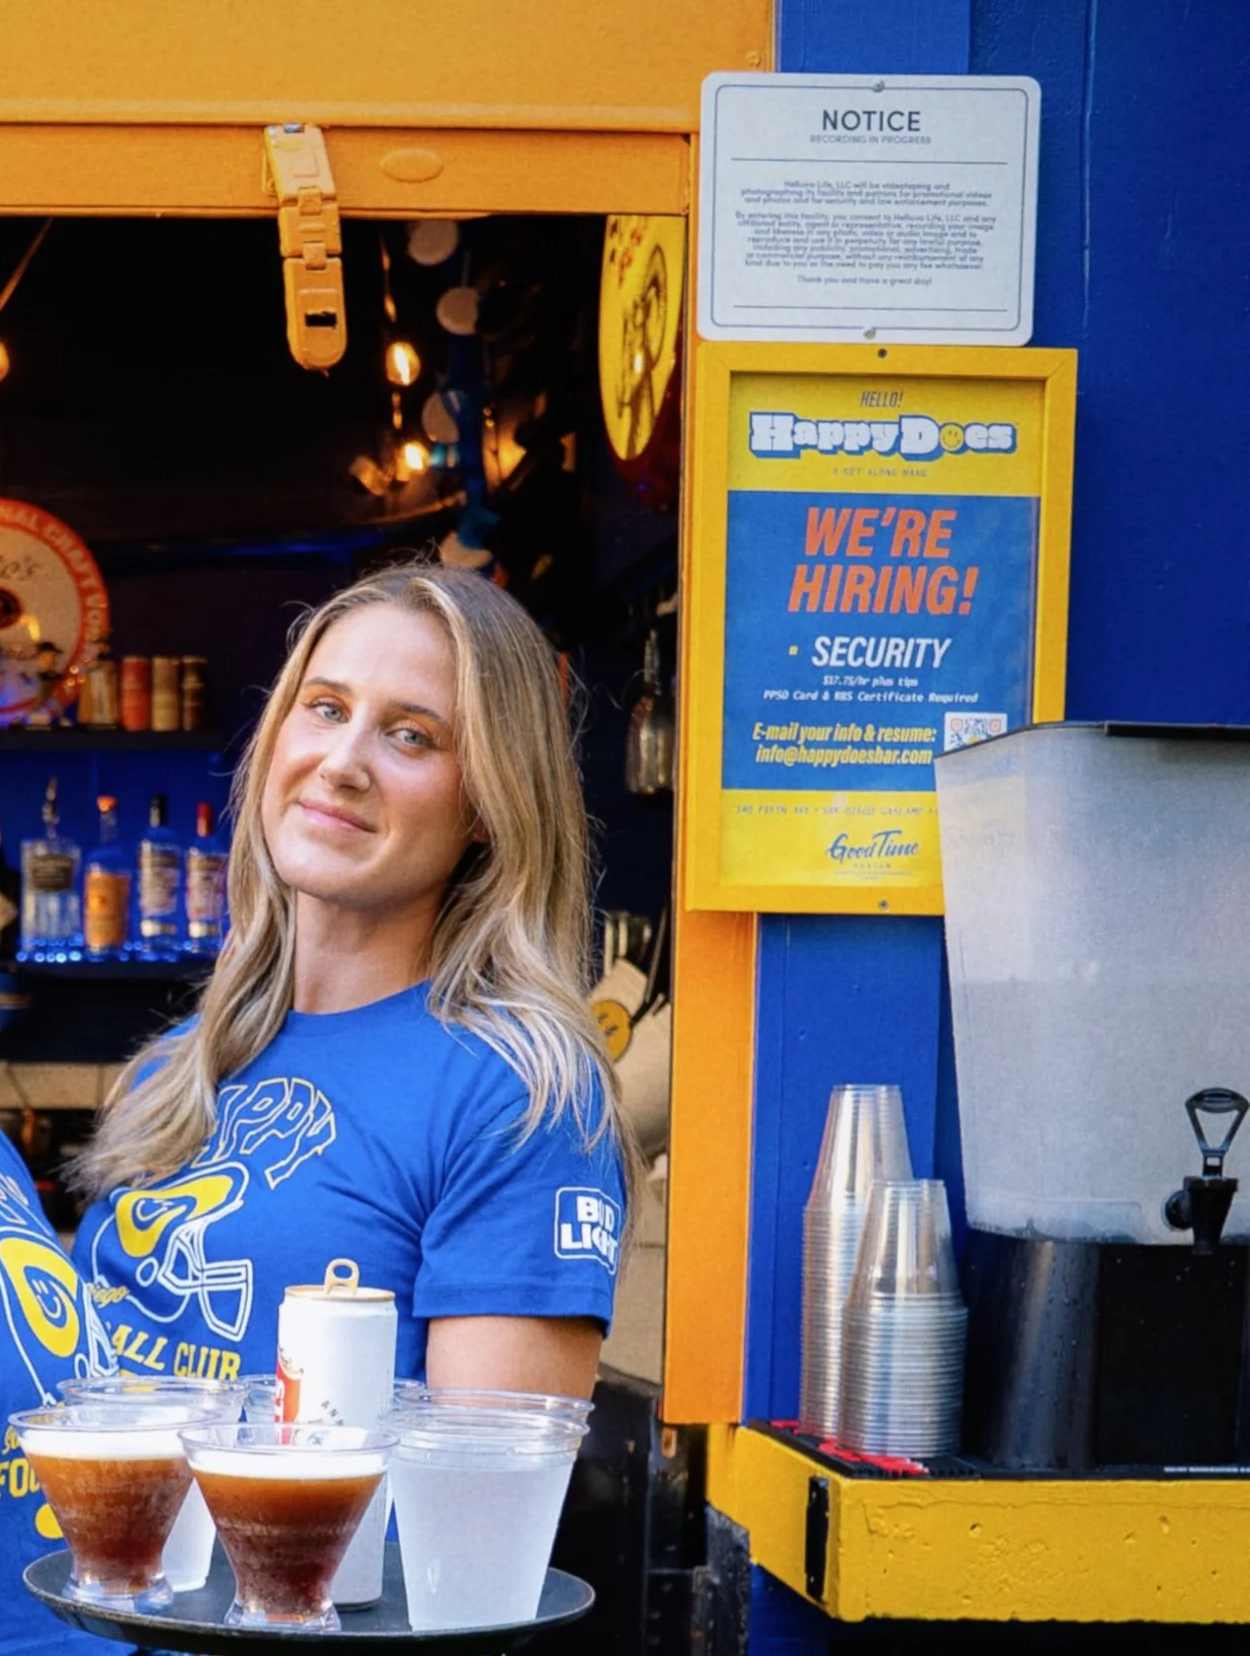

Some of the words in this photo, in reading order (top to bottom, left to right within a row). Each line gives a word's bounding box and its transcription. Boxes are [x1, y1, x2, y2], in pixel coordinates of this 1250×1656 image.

[822, 110, 921, 132] NOTICE
[810, 134, 868, 144] RECORDING
[869, 135, 879, 144] IN
[881, 136, 932, 145] PROGRESS
[860, 391, 903, 408] HELLO!
[804, 507, 957, 558] WE'RE
[788, 564, 979, 615] HIRING!
[812, 636, 952, 669] SECURITY
[872, 676, 894, 688] plus
[898, 677, 918, 688] tips
[793, 690, 818, 701] Card
[858, 692, 924, 702] Certificate
[928, 693, 978, 704] Required
[752, 722, 798, 741] E-mail
[798, 726, 832, 744] your
[832, 724, 862, 742] info
[864, 724, 876, 740] &
[877, 727, 937, 743] resume:
[756, 744, 933, 767] info@happydoesbar.com
[828, 833, 877, 864] Good
[872, 830, 919, 859] Time
[576, 1195, 615, 1233] BUD
[560, 1222, 618, 1265] LIGHT
